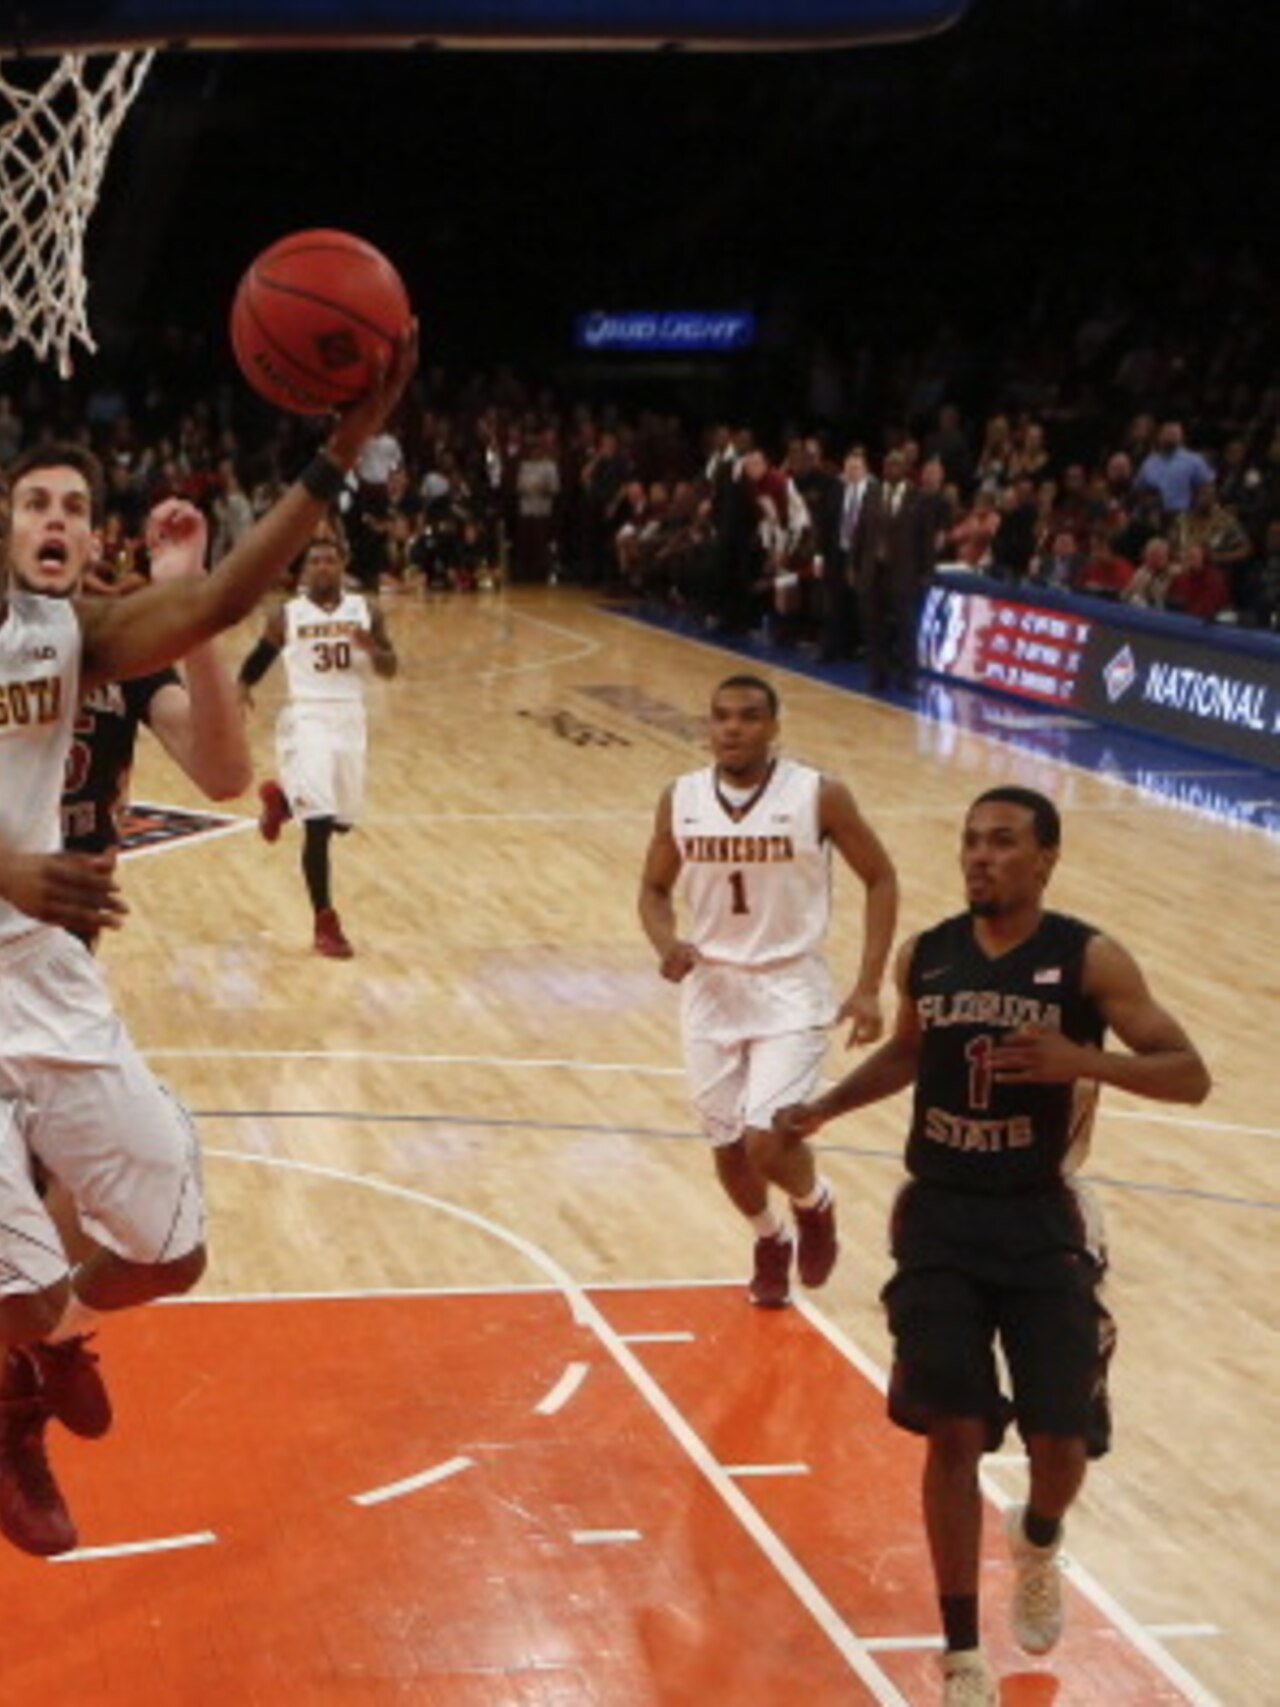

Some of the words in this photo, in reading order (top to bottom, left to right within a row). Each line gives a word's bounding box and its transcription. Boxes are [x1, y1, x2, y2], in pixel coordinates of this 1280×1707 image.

[313, 642, 351, 672] 30
[1146, 662, 1267, 730] NATIONAL
[728, 870, 750, 914] 1
[964, 1034, 992, 1110] 1
[925, 1108, 1033, 1152] STATE
